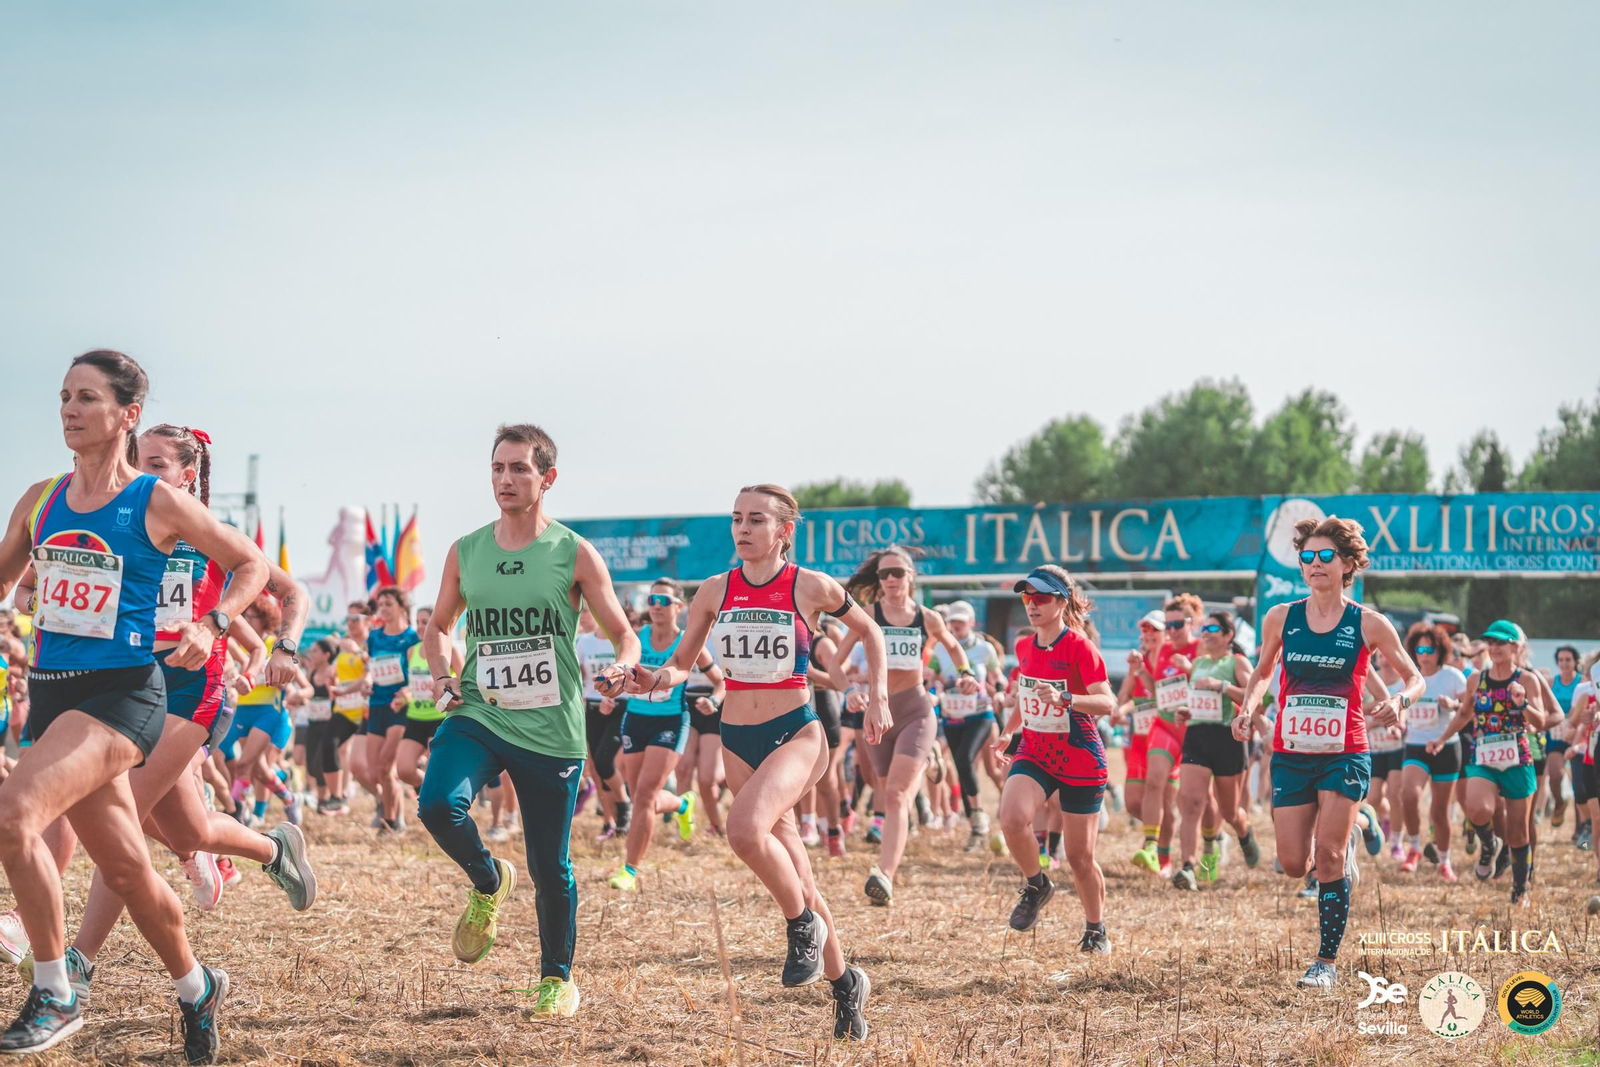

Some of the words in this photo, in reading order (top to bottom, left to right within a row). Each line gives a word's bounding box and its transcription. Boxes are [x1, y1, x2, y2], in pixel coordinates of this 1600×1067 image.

[836, 516, 925, 545] CROSS
[965, 501, 1191, 564] ITÁLICA
[1367, 504, 1498, 553] XLIII
[1502, 504, 1600, 535] CROS
[52, 550, 96, 566] ITÁLICA
[1495, 554, 1544, 571] CROSS
[42, 575, 113, 613] 1487
[157, 583, 187, 608] 14
[466, 607, 566, 637] MARISCAL
[735, 610, 773, 621] ITÁLICA
[496, 642, 533, 653] ITÁLICA
[720, 634, 789, 660] 1146
[887, 642, 917, 657] 108
[1287, 652, 1346, 667] Vanessa
[486, 661, 552, 690] 1146
[1160, 687, 1188, 706] 1306
[1190, 697, 1219, 711] 1261
[1300, 697, 1330, 706] ITÁLICA
[1023, 697, 1065, 718] 1375
[1288, 716, 1342, 738] 1460
[1480, 747, 1515, 764] 1220
